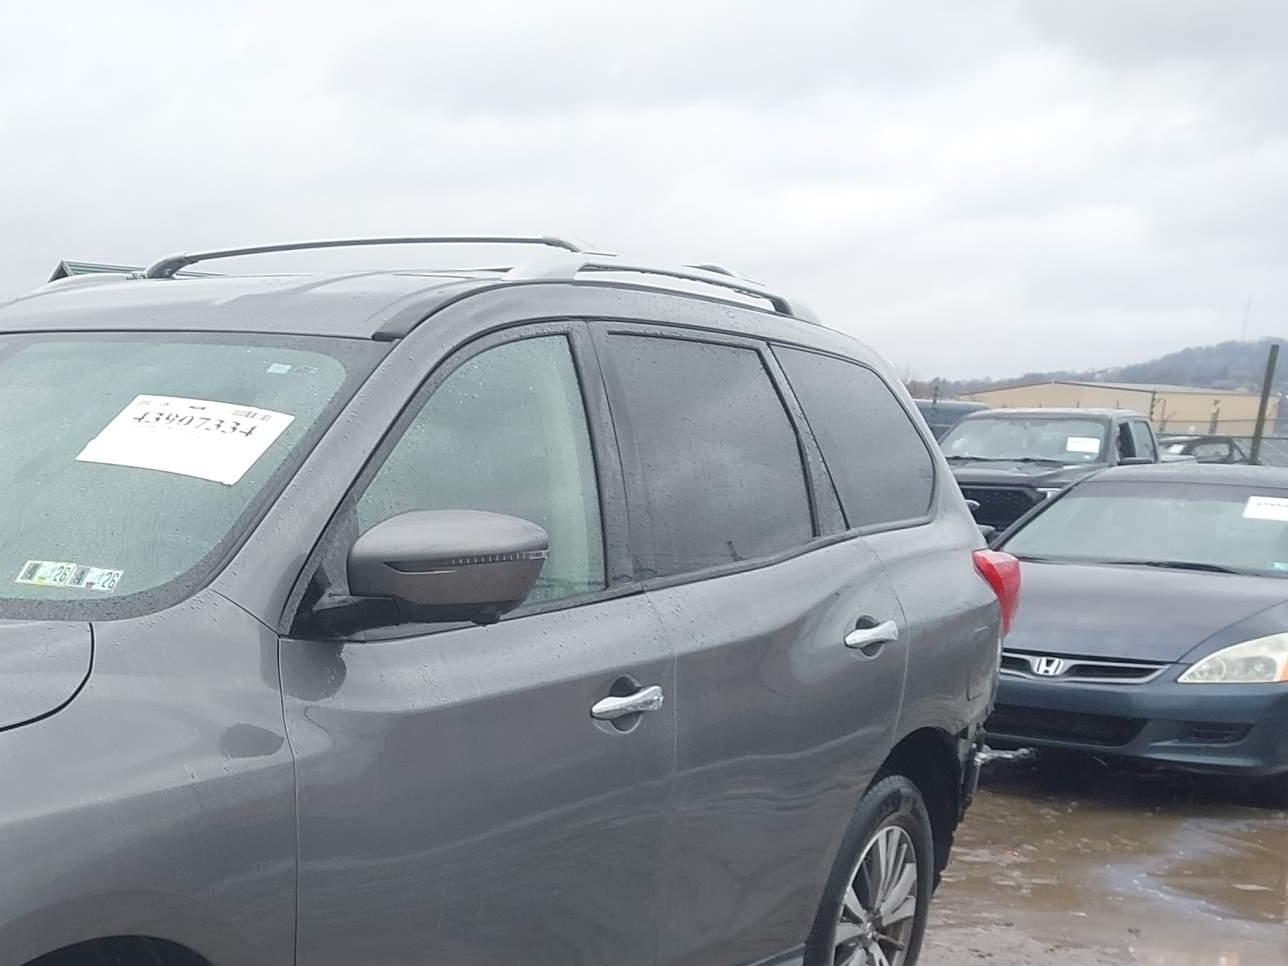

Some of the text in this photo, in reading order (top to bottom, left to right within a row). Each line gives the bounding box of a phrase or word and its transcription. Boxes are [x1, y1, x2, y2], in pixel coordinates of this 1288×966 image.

[133, 411, 258, 437] 43907334
[53, 565, 71, 582] 26
[100, 571, 120, 588] 26
